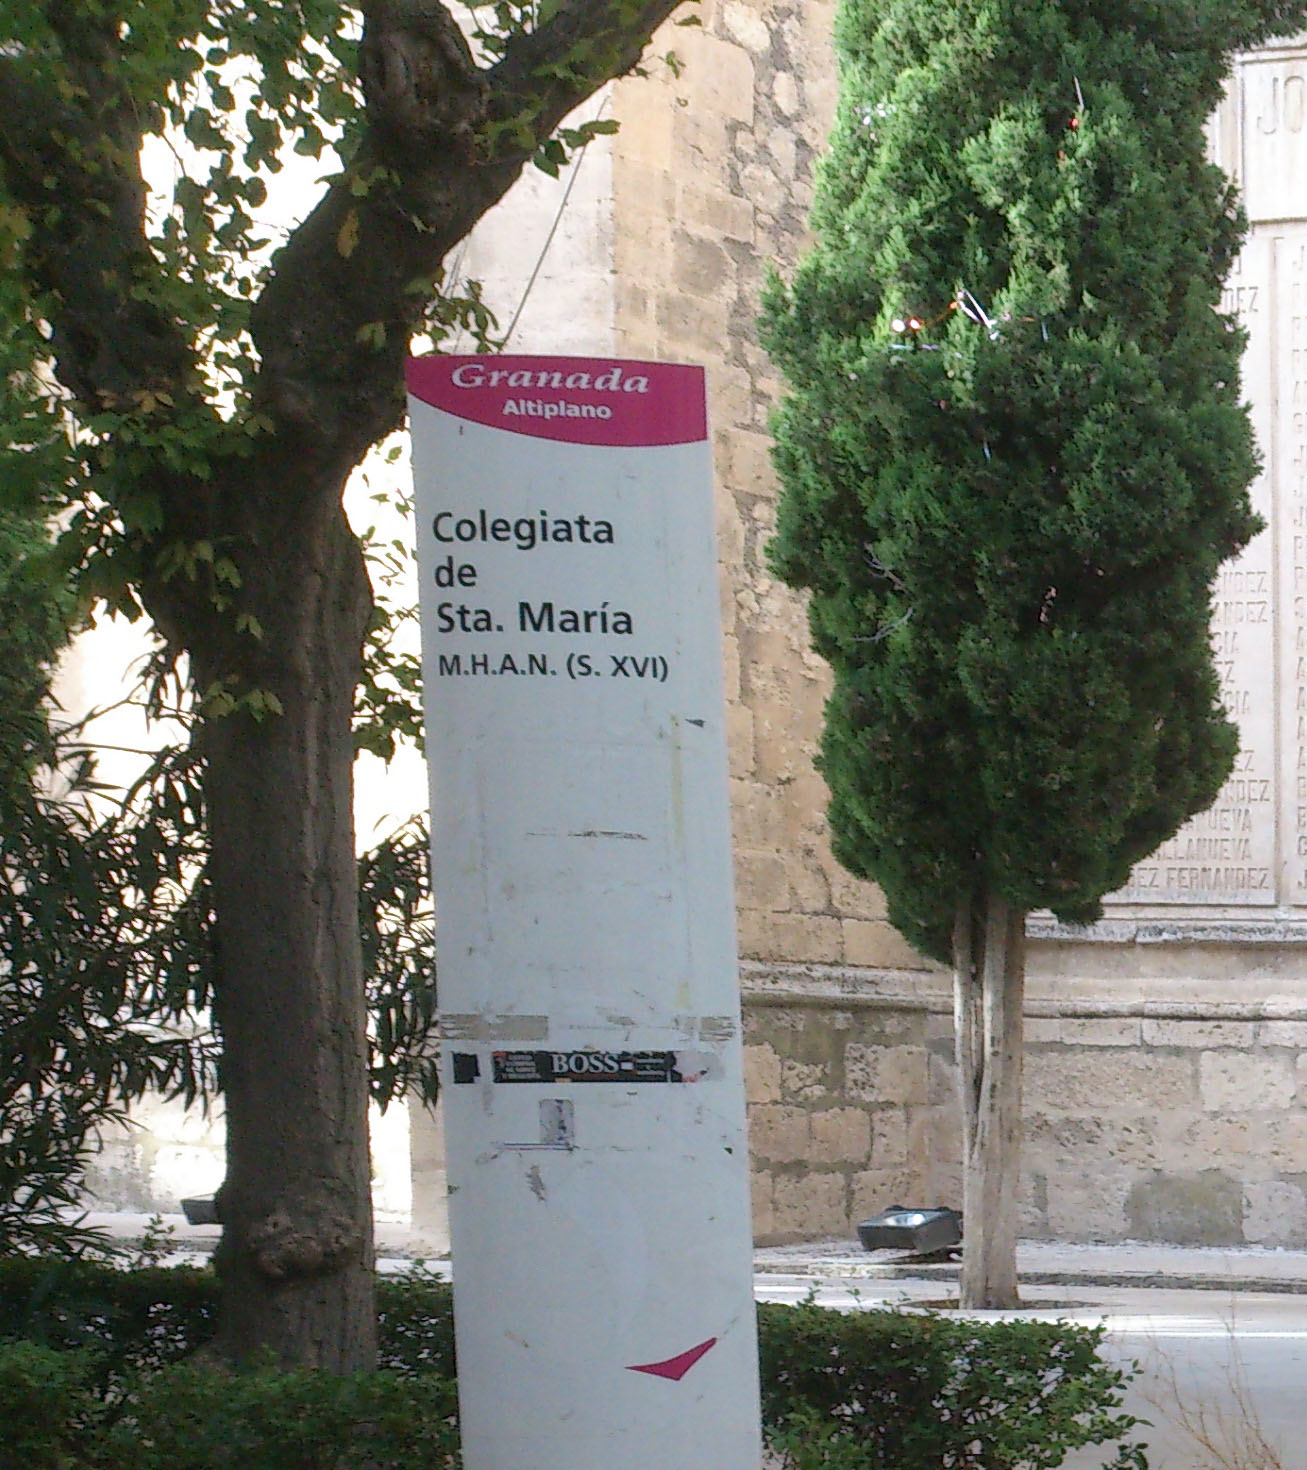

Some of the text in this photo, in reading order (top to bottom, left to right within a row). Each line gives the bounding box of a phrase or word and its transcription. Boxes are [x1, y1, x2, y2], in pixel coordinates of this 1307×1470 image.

[451, 364, 650, 394] Granada
[502, 399, 613, 420] Altiplano
[432, 509, 615, 550] Colegiata
[434, 556, 477, 588] de
[437, 601, 633, 635] Sta. María
[438, 653, 668, 682] M.H.A.N. (S. XVI)
[1166, 866, 1270, 891] FERNANDEZ
[552, 1053, 619, 1074] BOSS
